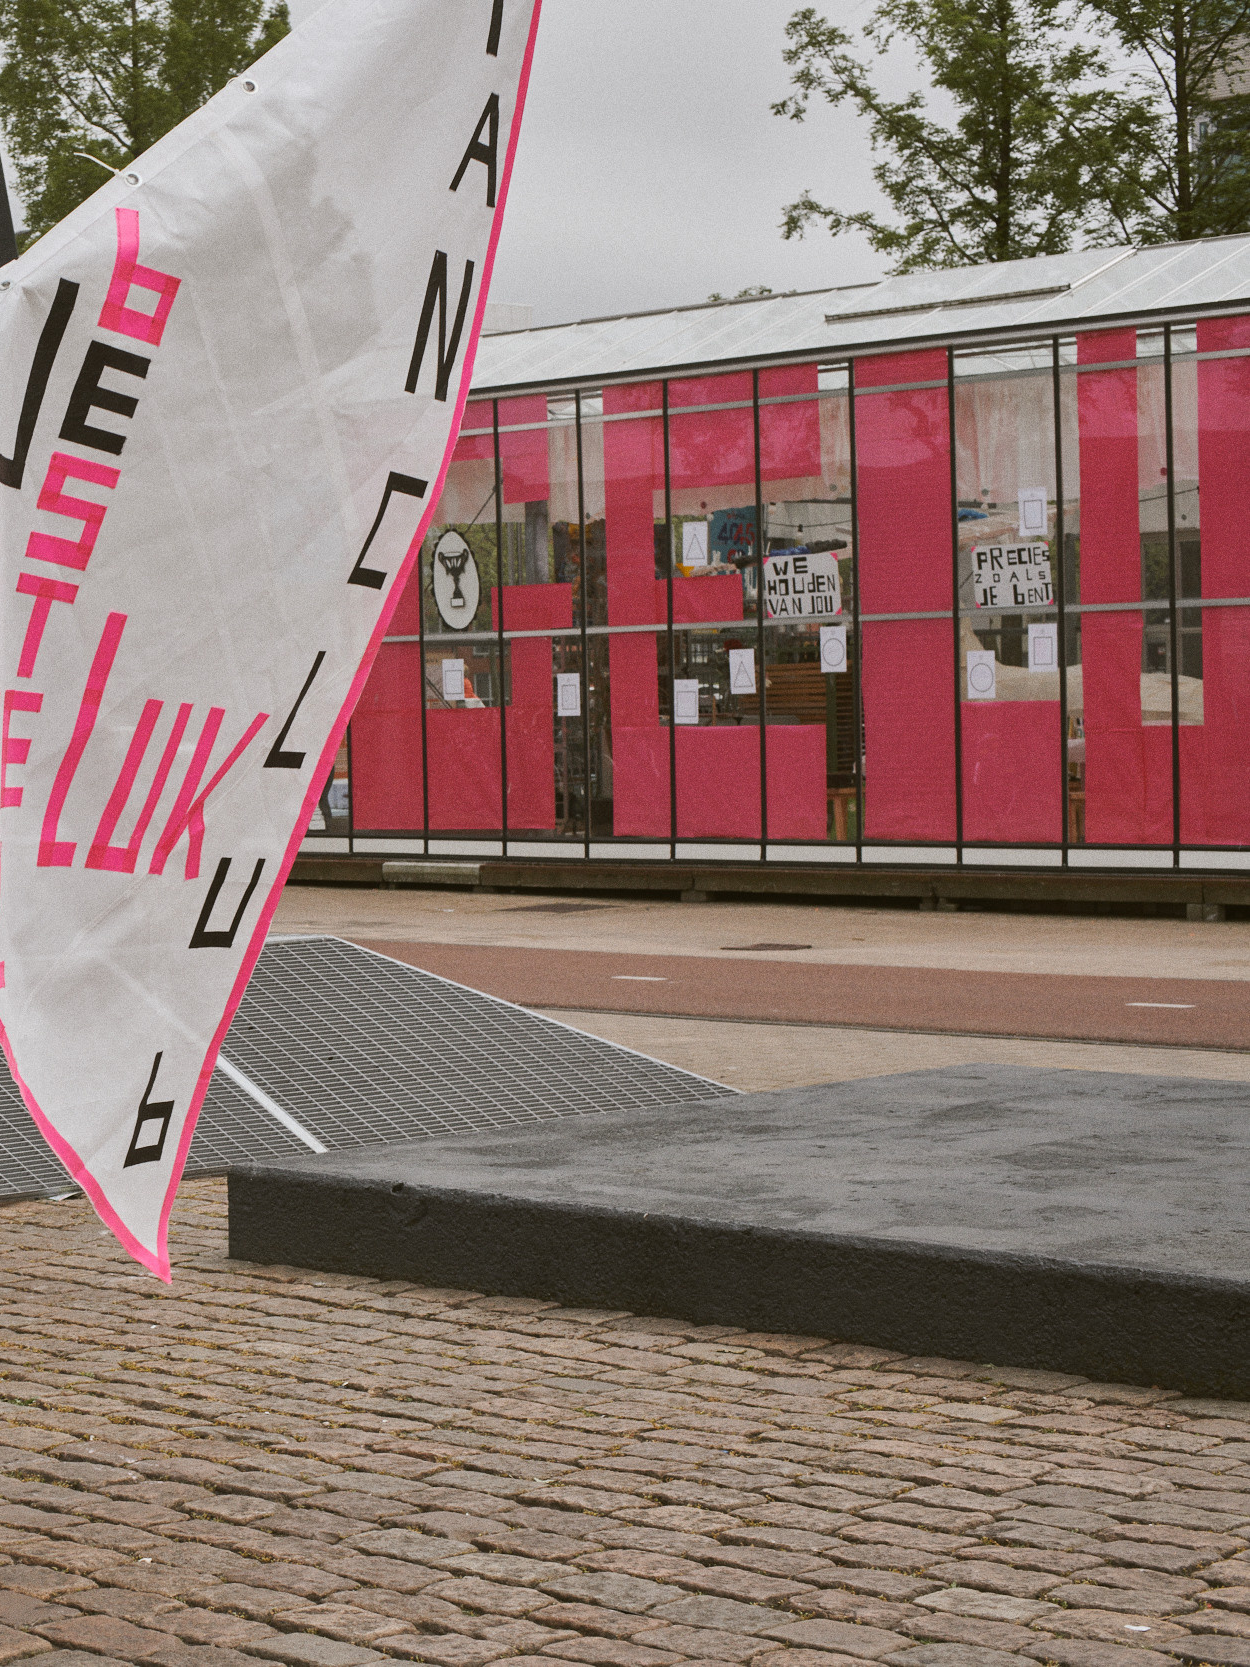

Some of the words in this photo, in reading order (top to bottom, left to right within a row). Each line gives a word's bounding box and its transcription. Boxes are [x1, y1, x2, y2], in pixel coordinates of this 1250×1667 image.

[772, 556, 808, 576] WE
[976, 546, 1050, 571] PRECIES
[975, 568, 1046, 584] ZOALS
[768, 597, 803, 616] VAN
[808, 595, 834, 615] JOU
[979, 586, 998, 607] JE
